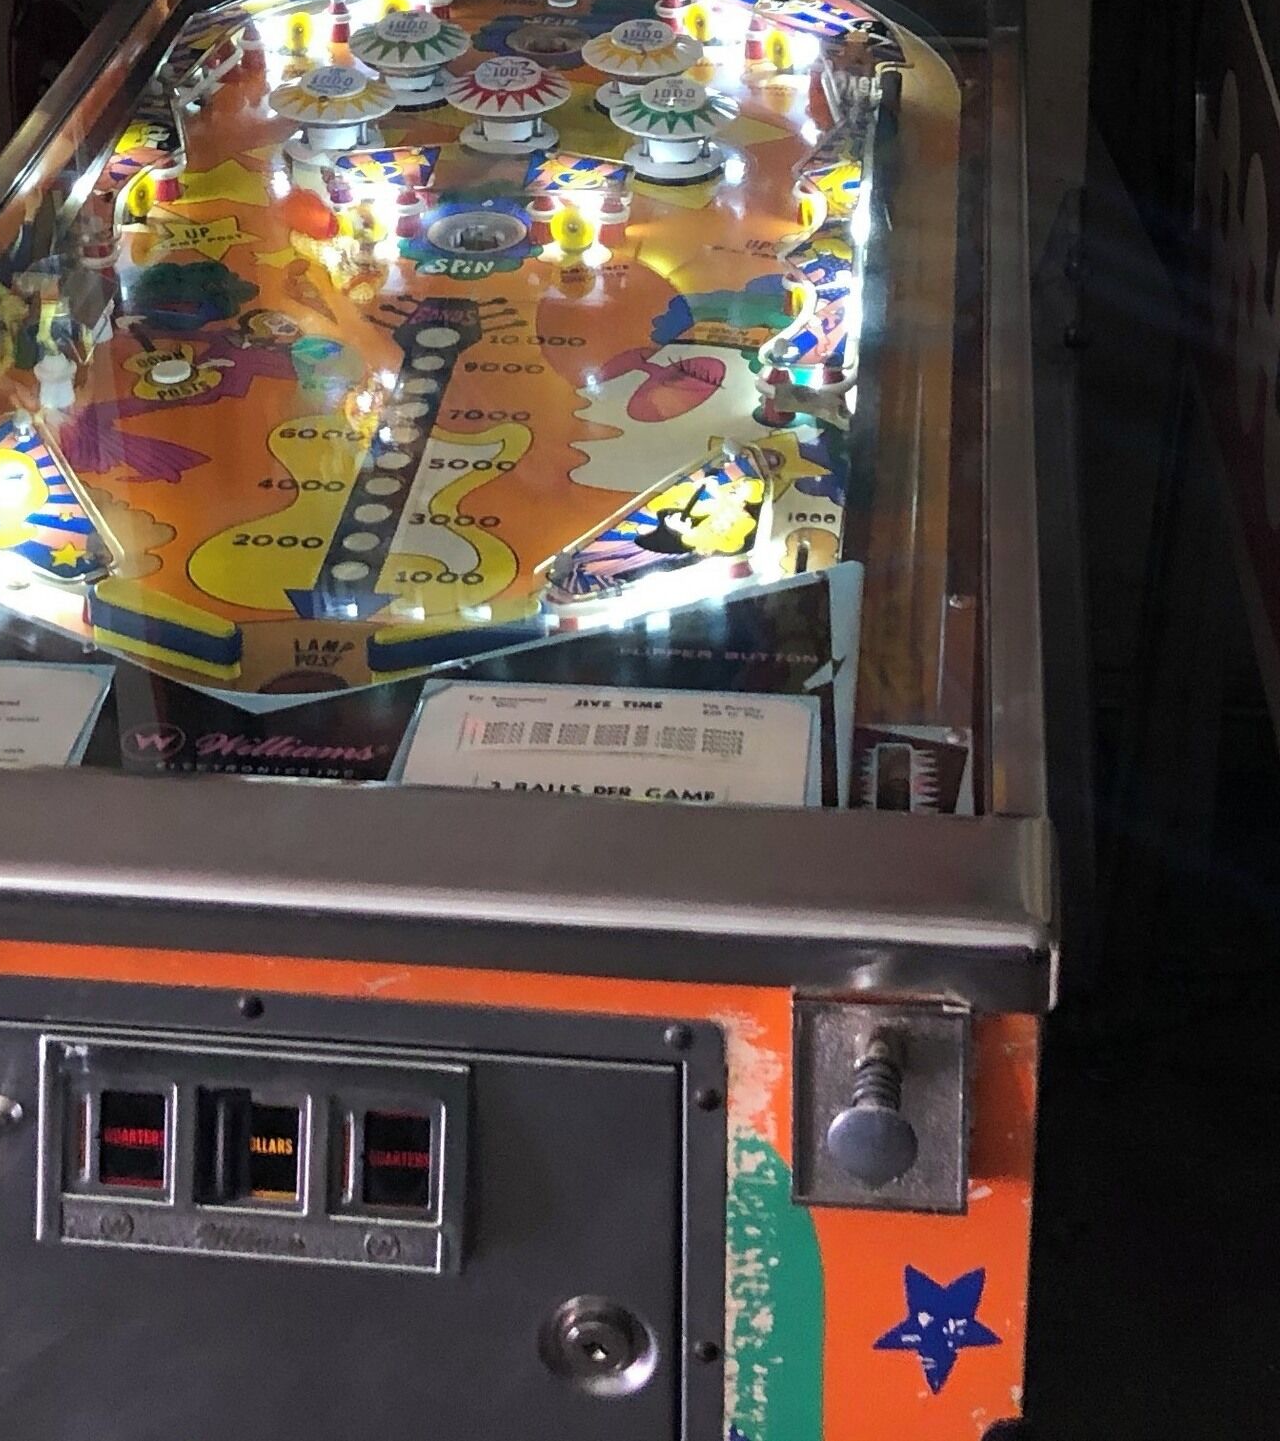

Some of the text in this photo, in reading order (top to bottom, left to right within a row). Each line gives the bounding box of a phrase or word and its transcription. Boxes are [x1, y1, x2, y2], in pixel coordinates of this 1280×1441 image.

[185, 227, 211, 240] UP
[448, 409, 531, 422] 7000
[427, 457, 518, 474] 5000
[257, 477, 346, 493] 4000
[409, 511, 502, 530] 3000
[231, 533, 326, 550] 2000
[395, 568, 486, 587] 1000
[293, 637, 356, 654] LAMP
